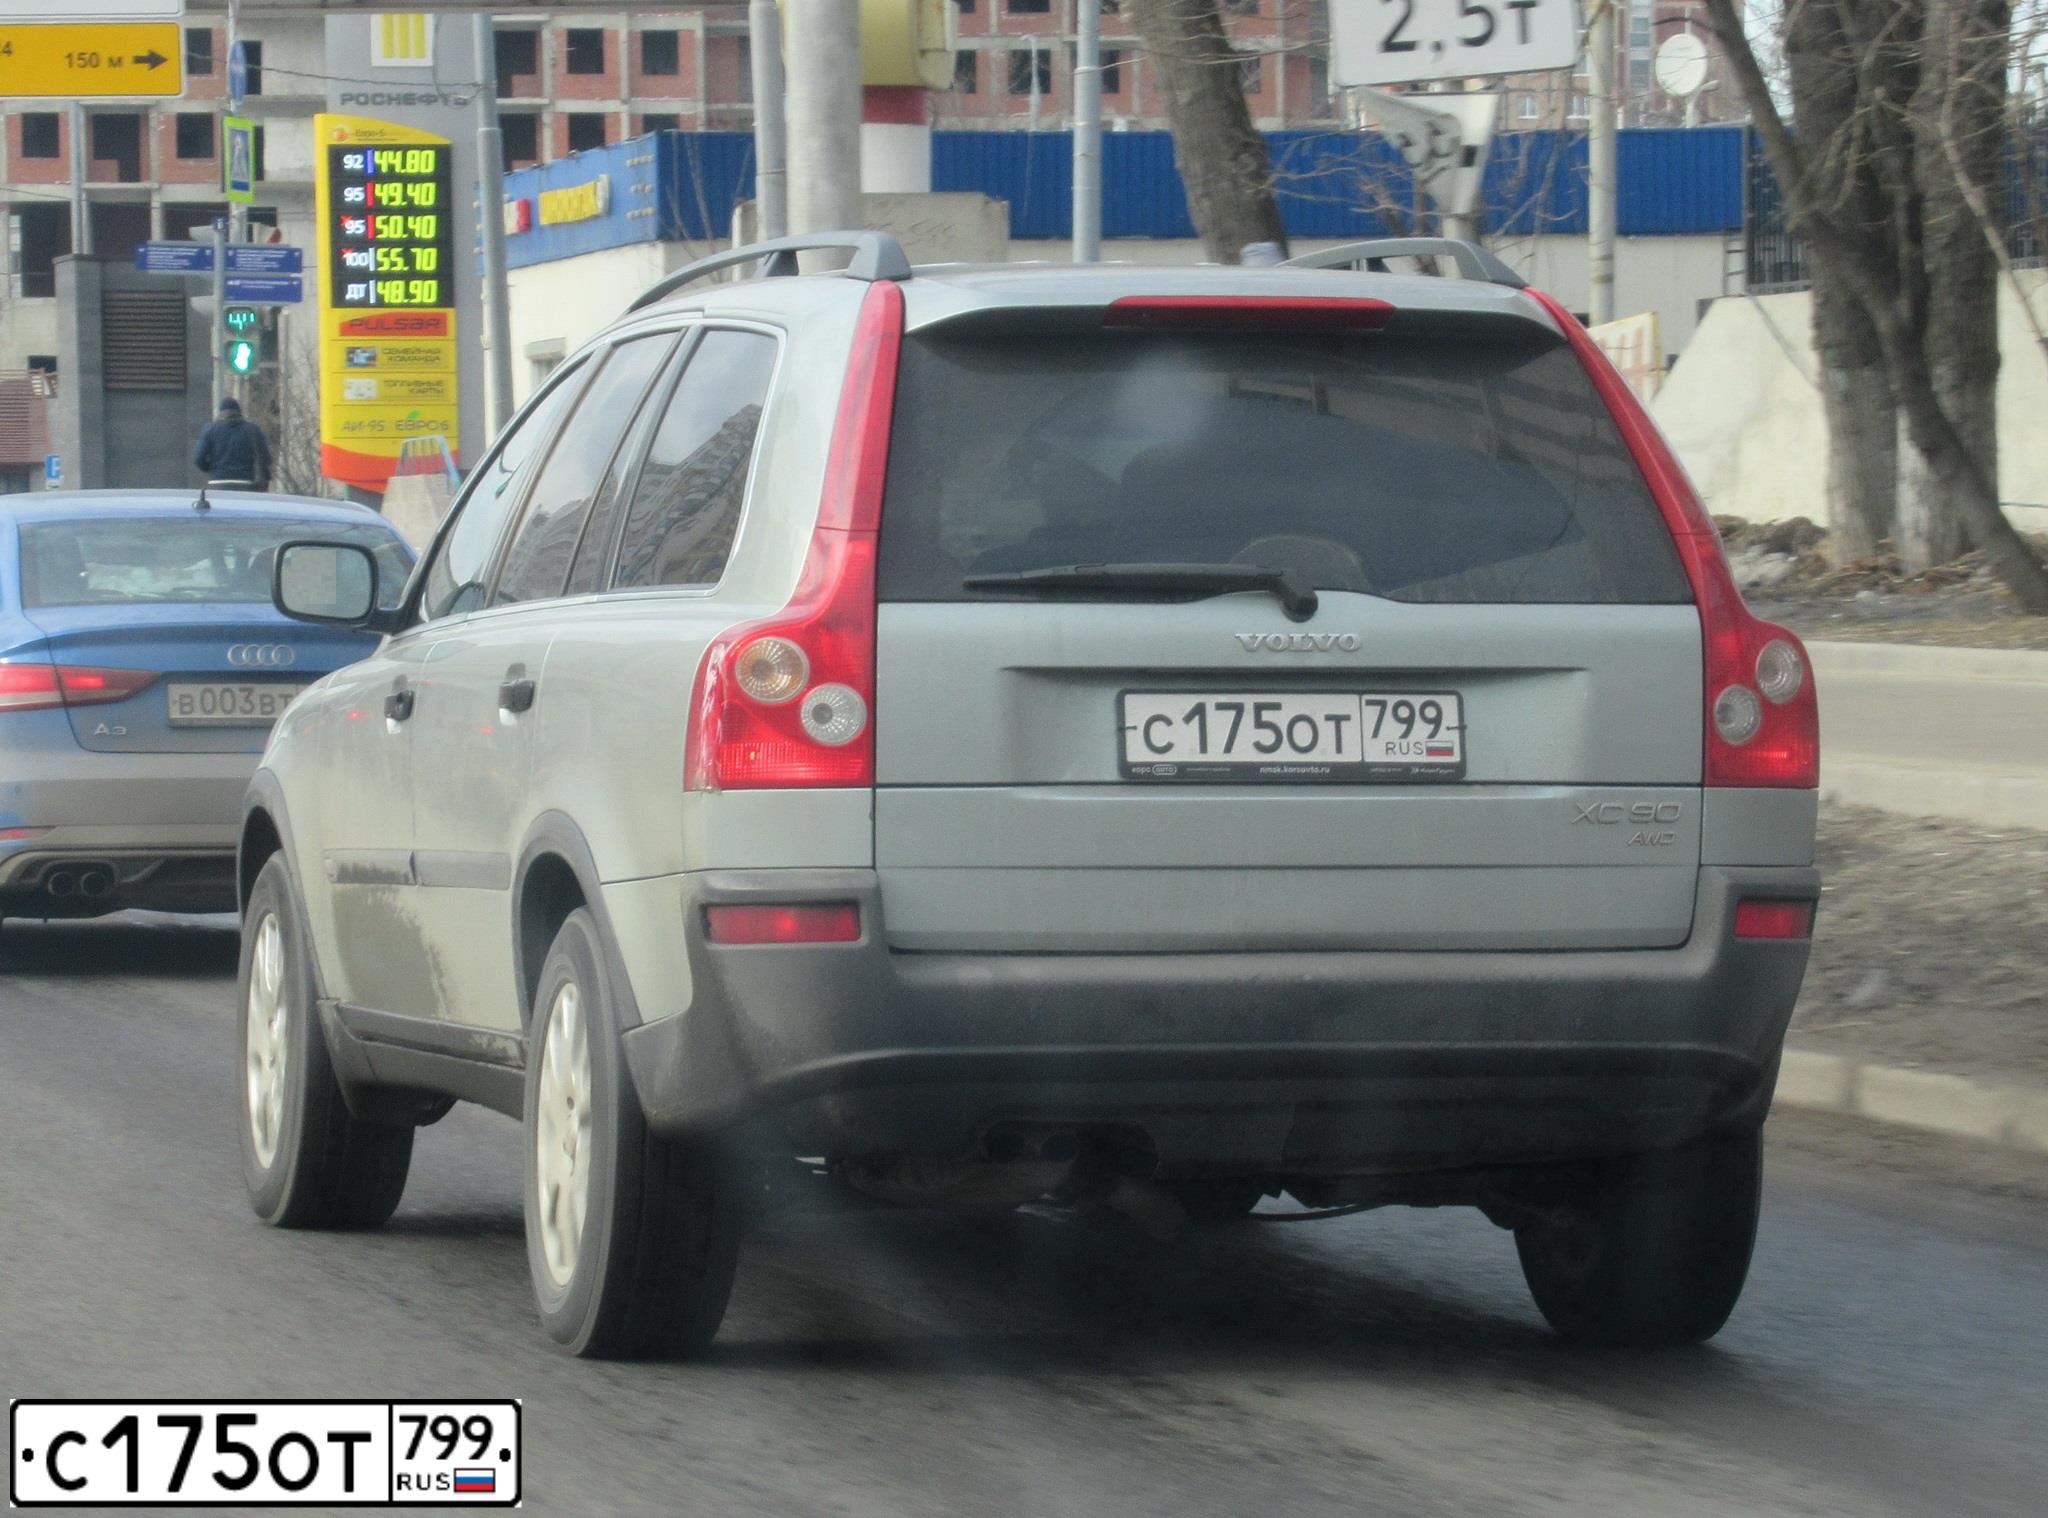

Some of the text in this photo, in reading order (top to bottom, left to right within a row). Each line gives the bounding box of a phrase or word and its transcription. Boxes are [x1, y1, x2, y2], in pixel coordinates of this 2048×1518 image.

[65, 53, 100, 68] 150
[340, 92, 469, 106] РОСНЕФТЬ
[343, 150, 436, 173] 92 44.80
[344, 182, 436, 206] 95 49.40
[344, 215, 437, 238] 95 50.40
[343, 247, 438, 271] 100 55.70
[345, 280, 438, 304] ДТ 48.90
[1235, 633, 1361, 651] VOLVO
[94, 723, 127, 736] A3
[1143, 699, 1444, 754] С175ОТ 799
[1385, 741, 1425, 756] RUS
[1627, 831, 1675, 847] AWD
